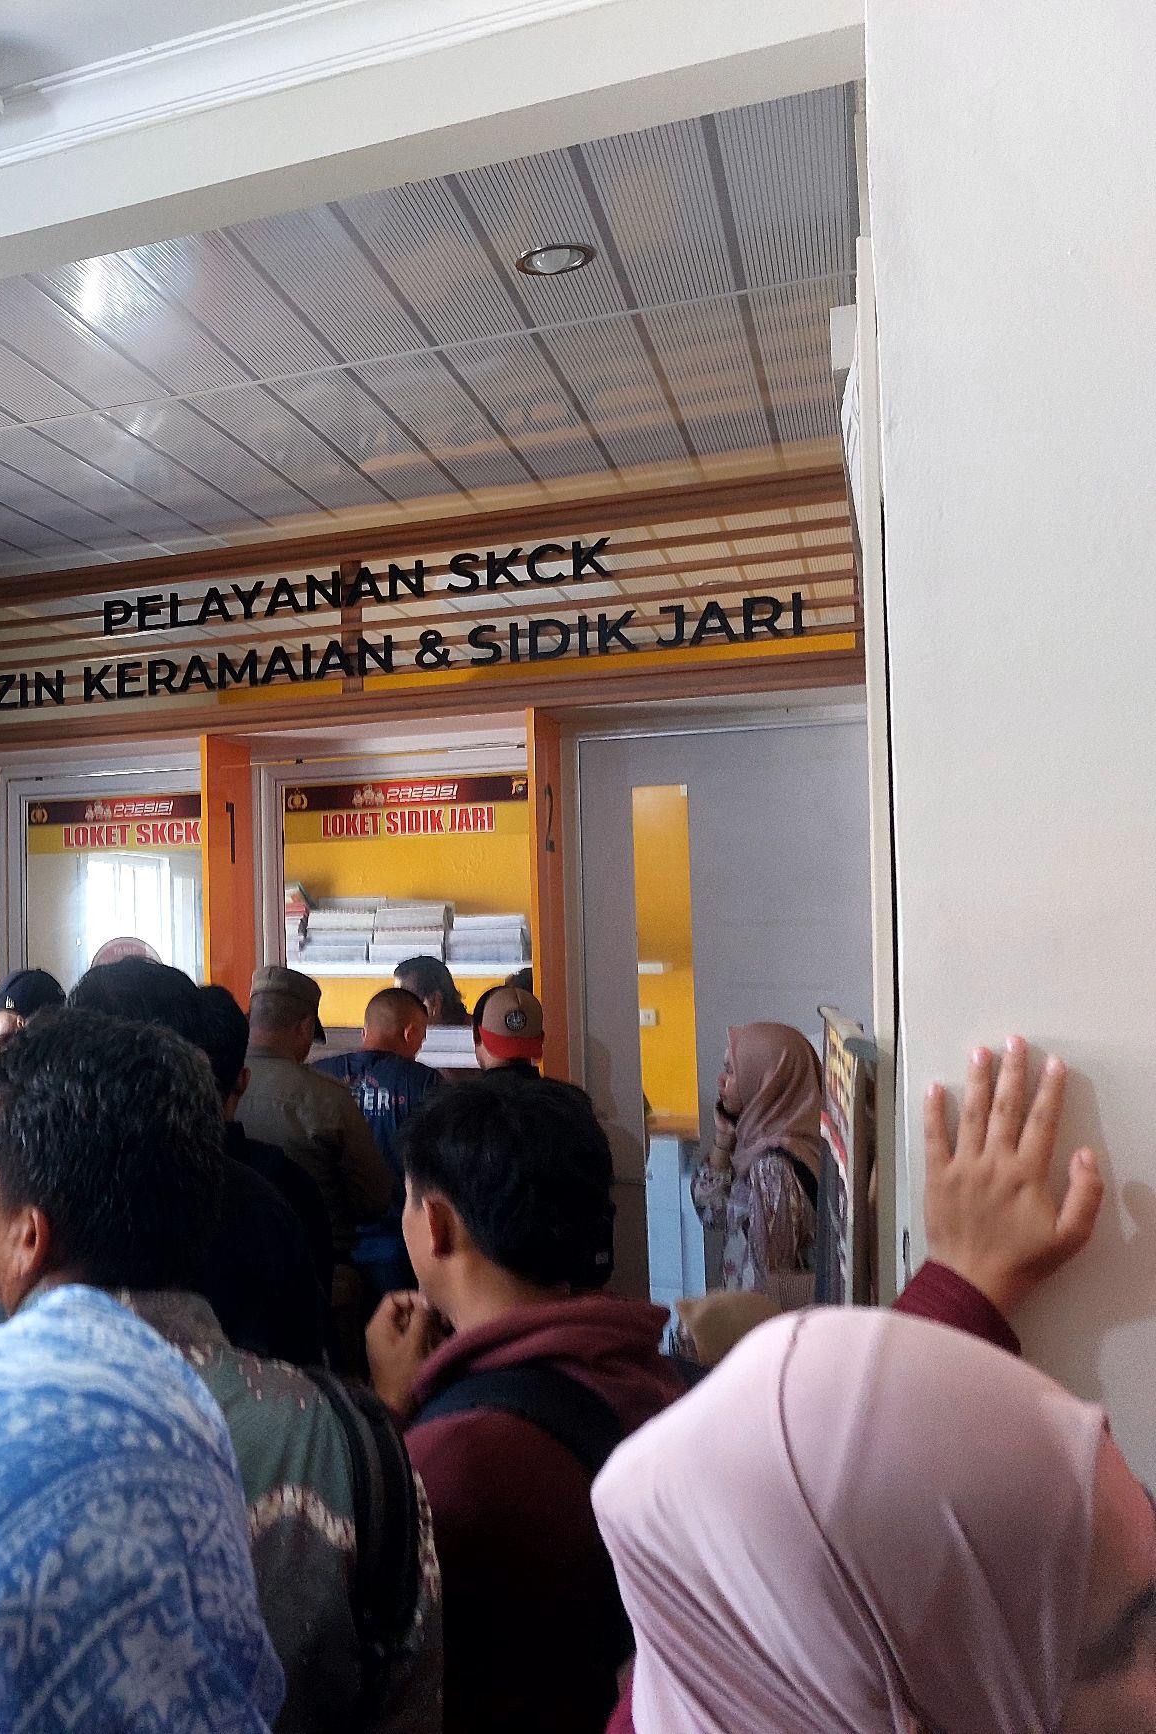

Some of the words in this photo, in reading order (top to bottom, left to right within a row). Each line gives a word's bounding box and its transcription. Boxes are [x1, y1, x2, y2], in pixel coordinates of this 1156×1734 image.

[102, 559, 426, 637] PELAYANAN
[447, 536, 610, 595] SKCK
[82, 633, 394, 702] KERAMAIAN
[414, 629, 452, 670] &
[467, 609, 637, 666] SIDIK
[656, 591, 805, 648] JARI
[63, 824, 131, 849] LOKET
[136, 820, 202, 846] SKCK
[321, 812, 382, 838] LOKET
[385, 809, 445, 835] SIDIK
[448, 804, 496, 832] JARI
